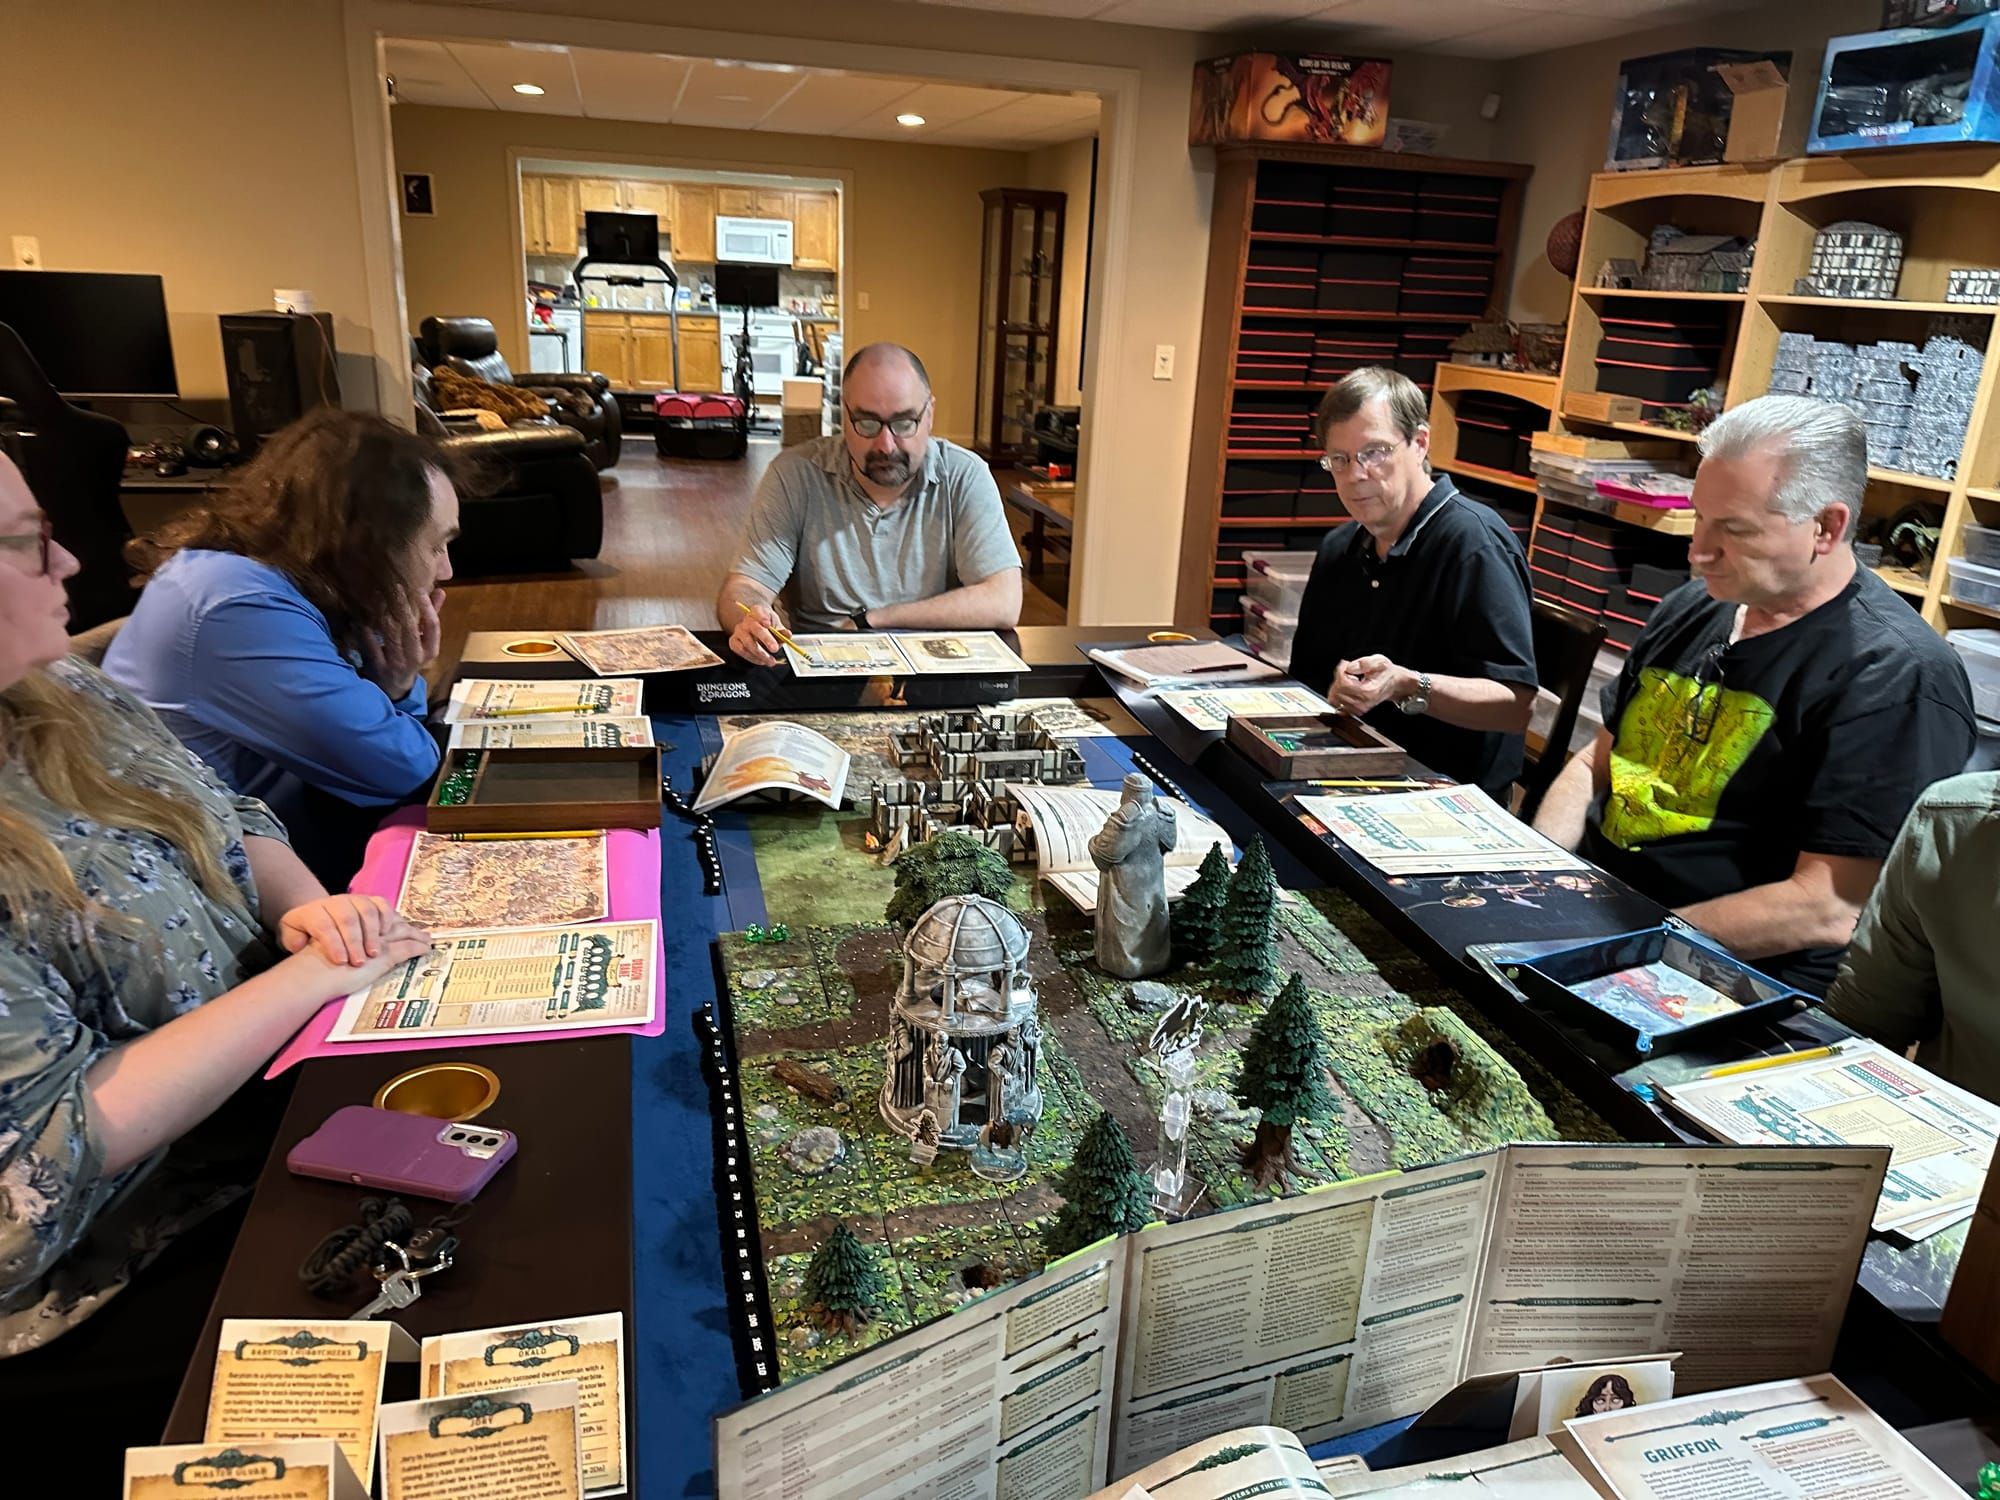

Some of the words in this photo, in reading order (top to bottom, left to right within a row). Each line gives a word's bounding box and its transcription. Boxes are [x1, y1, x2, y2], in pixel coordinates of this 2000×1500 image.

[696, 682, 747, 691] DUNGEONS
[708, 690, 751, 698] DRAGONS
[748, 1313, 758, 1328] 100
[489, 1375, 512, 1387] heavily
[513, 1373, 541, 1382] tattooed
[541, 1369, 561, 1379] dwarf
[561, 1368, 585, 1376] woman
[585, 1365, 600, 1373] with
[756, 1362, 767, 1377] 110
[1643, 1437, 1723, 1464] GRIFFON
